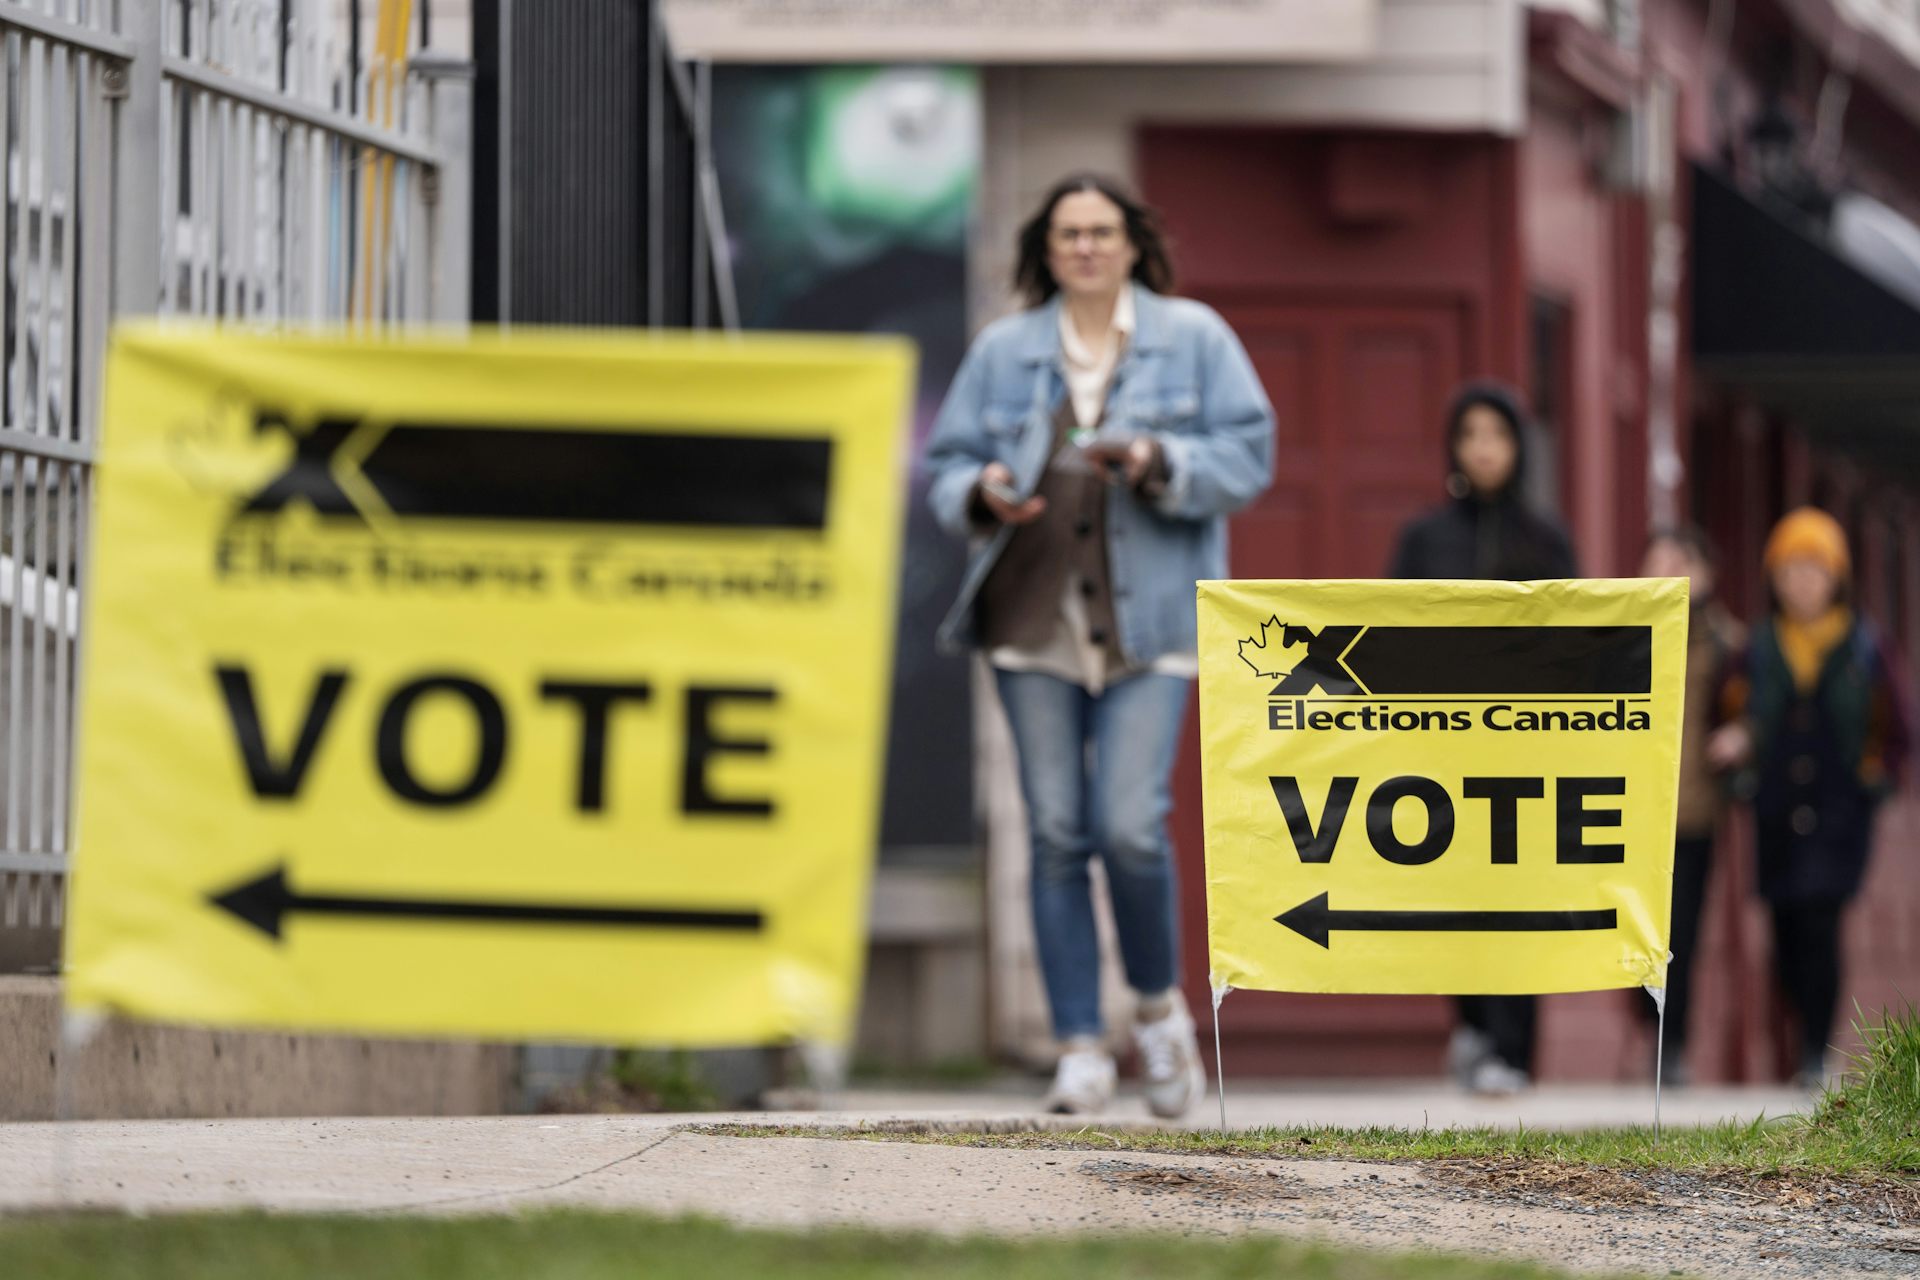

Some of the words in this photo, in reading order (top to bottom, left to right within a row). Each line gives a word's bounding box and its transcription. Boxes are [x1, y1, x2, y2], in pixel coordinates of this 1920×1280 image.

[211, 661, 781, 823] VOTE
[1267, 699, 1473, 732] Elections
[1481, 699, 1652, 732] Canada
[1267, 774, 1627, 867] VOTE
